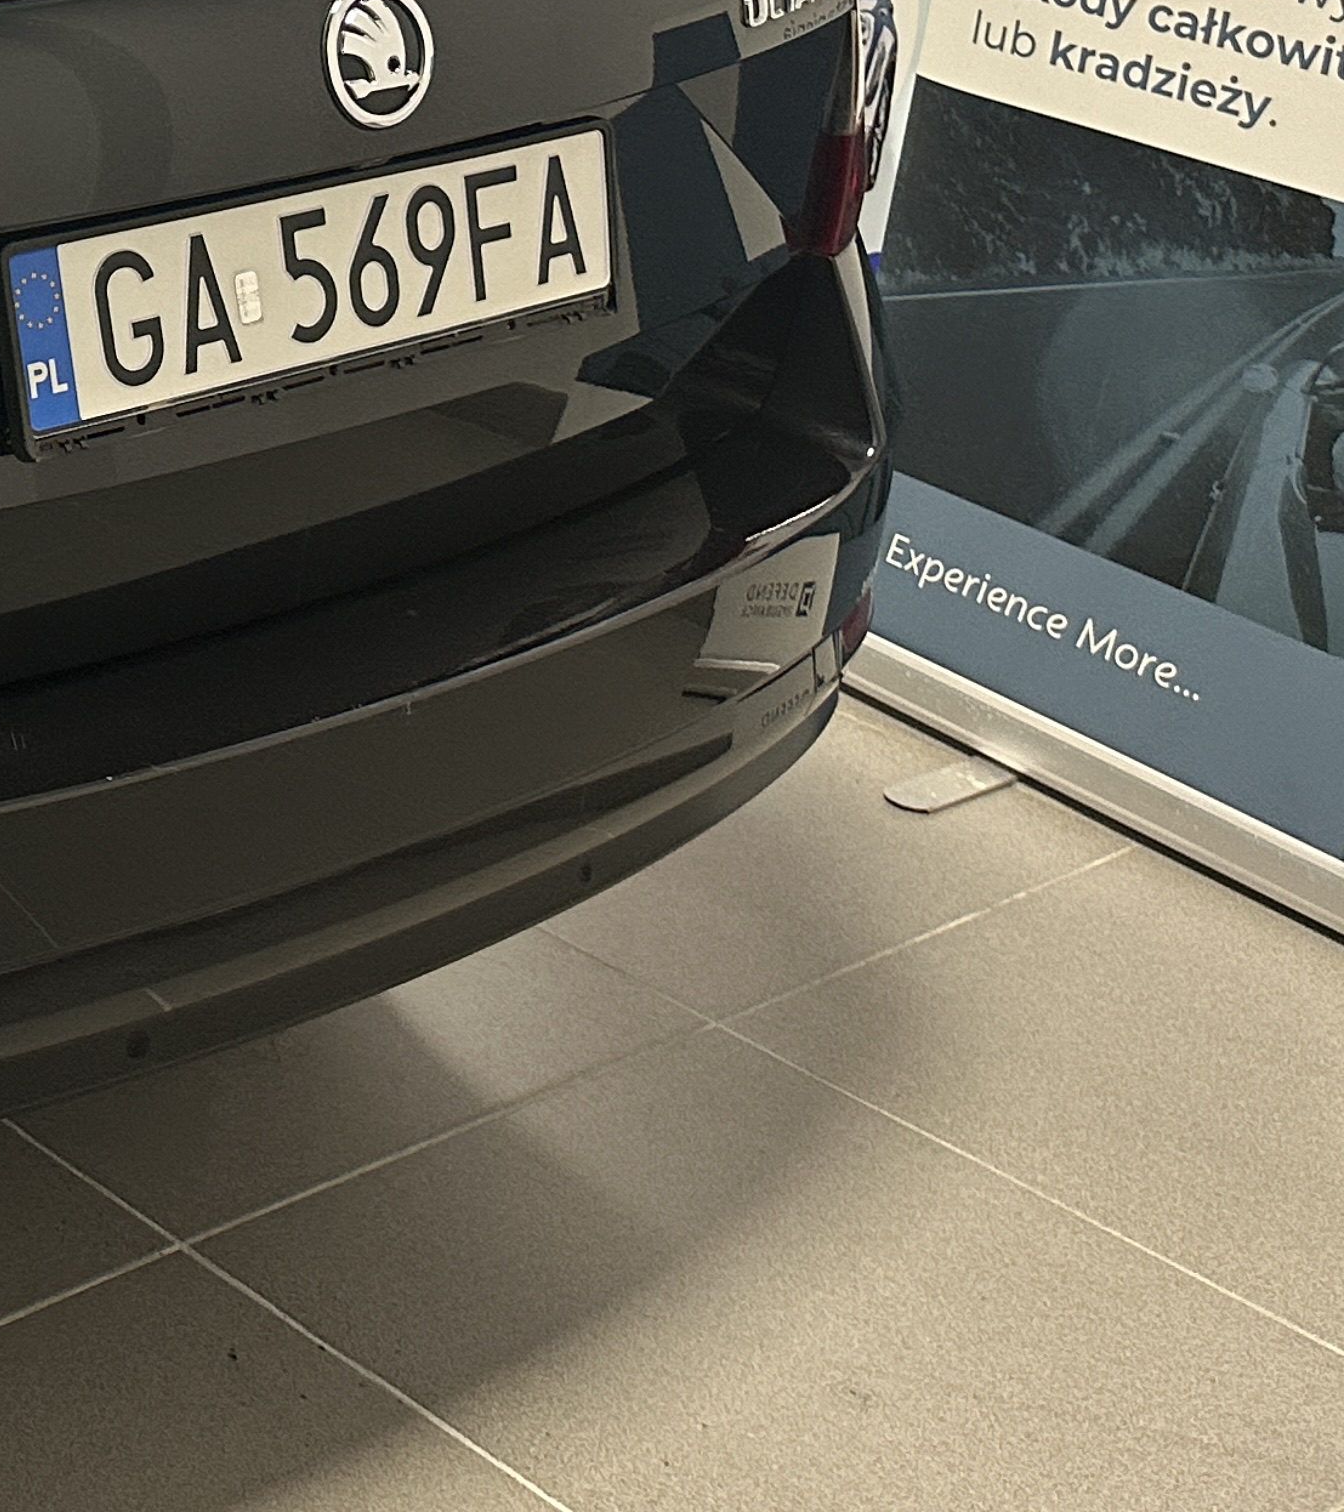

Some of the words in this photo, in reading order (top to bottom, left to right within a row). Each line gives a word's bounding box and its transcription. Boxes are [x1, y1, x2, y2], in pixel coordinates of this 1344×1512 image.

[972, 8, 1037, 59] lub
[1049, 30, 1278, 129] kradzieży.
[26, 358, 69, 399] PL
[94, 233, 243, 387] GA
[278, 155, 587, 344] 569FA
[884, 533, 1069, 640] Experience
[1075, 617, 1200, 702] More...
